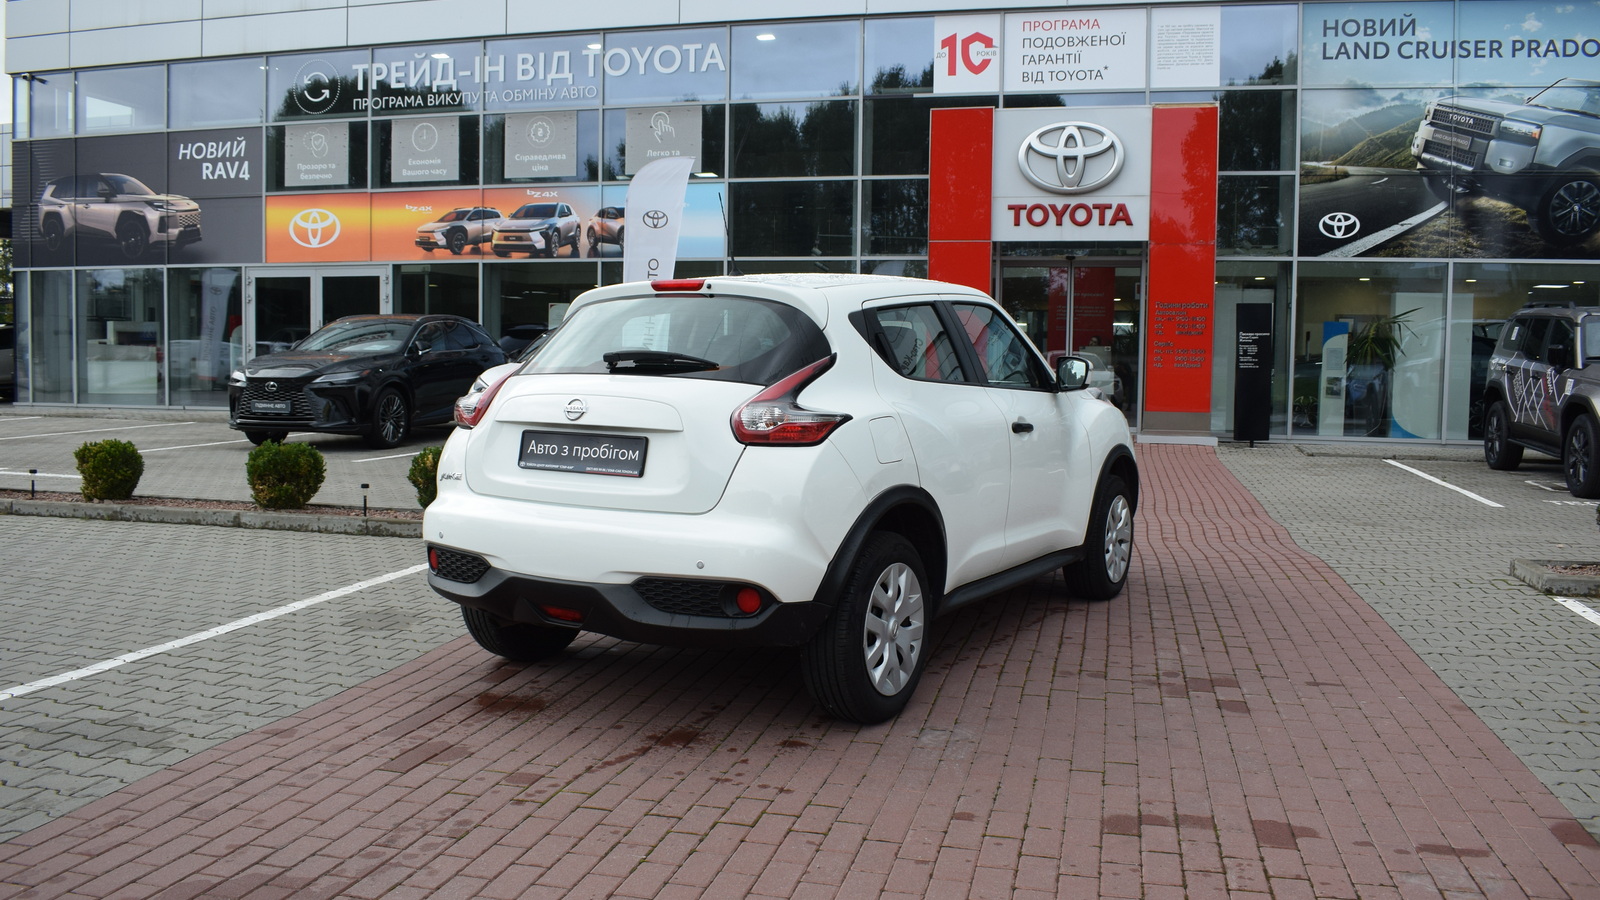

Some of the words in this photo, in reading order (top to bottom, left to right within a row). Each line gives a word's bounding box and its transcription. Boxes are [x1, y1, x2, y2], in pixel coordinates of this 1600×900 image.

[1022, 18, 1100, 32] ПРОГРАМА
[1322, 14, 1416, 38] НОВИЙ
[1022, 32, 1126, 50] ПОДОВЖЕНОЇ
[1322, 42, 1390, 60] LAND
[1398, 40, 1502, 59] CRUISER
[1512, 38, 1600, 58] PRADO
[1022, 50, 1081, 66] ГАРАНТІЇ
[352, 52, 504, 90] ТРЕЙД-ІН
[518, 52, 573, 86] ВІД
[582, 43, 726, 78] TOYOTA
[1022, 71, 1044, 84] ВІД
[352, 94, 424, 111] ПРОГРАМА
[427, 91, 480, 107] ВИКУПУ
[483, 90, 500, 103] ТА
[503, 87, 557, 102] ОБМІНУ
[560, 86, 598, 100] АВТО
[1450, 114, 1474, 124] TOYOTA
[178, 136, 246, 160] НОВИЙ
[408, 158, 441, 166] Економія
[515, 152, 566, 162] Справедлива
[202, 161, 250, 181] RAV4
[296, 163, 328, 172] Прозоро
[402, 168, 427, 178] Вашого
[429, 168, 448, 177] часу
[532, 163, 549, 172] ціна
[1008, 202, 1134, 226] TOYOTA
[1155, 302, 1181, 310] Години
[1182, 302, 1208, 310] роботи
[527, 440, 558, 456] Авто
[561, 444, 569, 456] з
[572, 442, 639, 461] пробігом
[440, 472, 462, 481] JUKE
